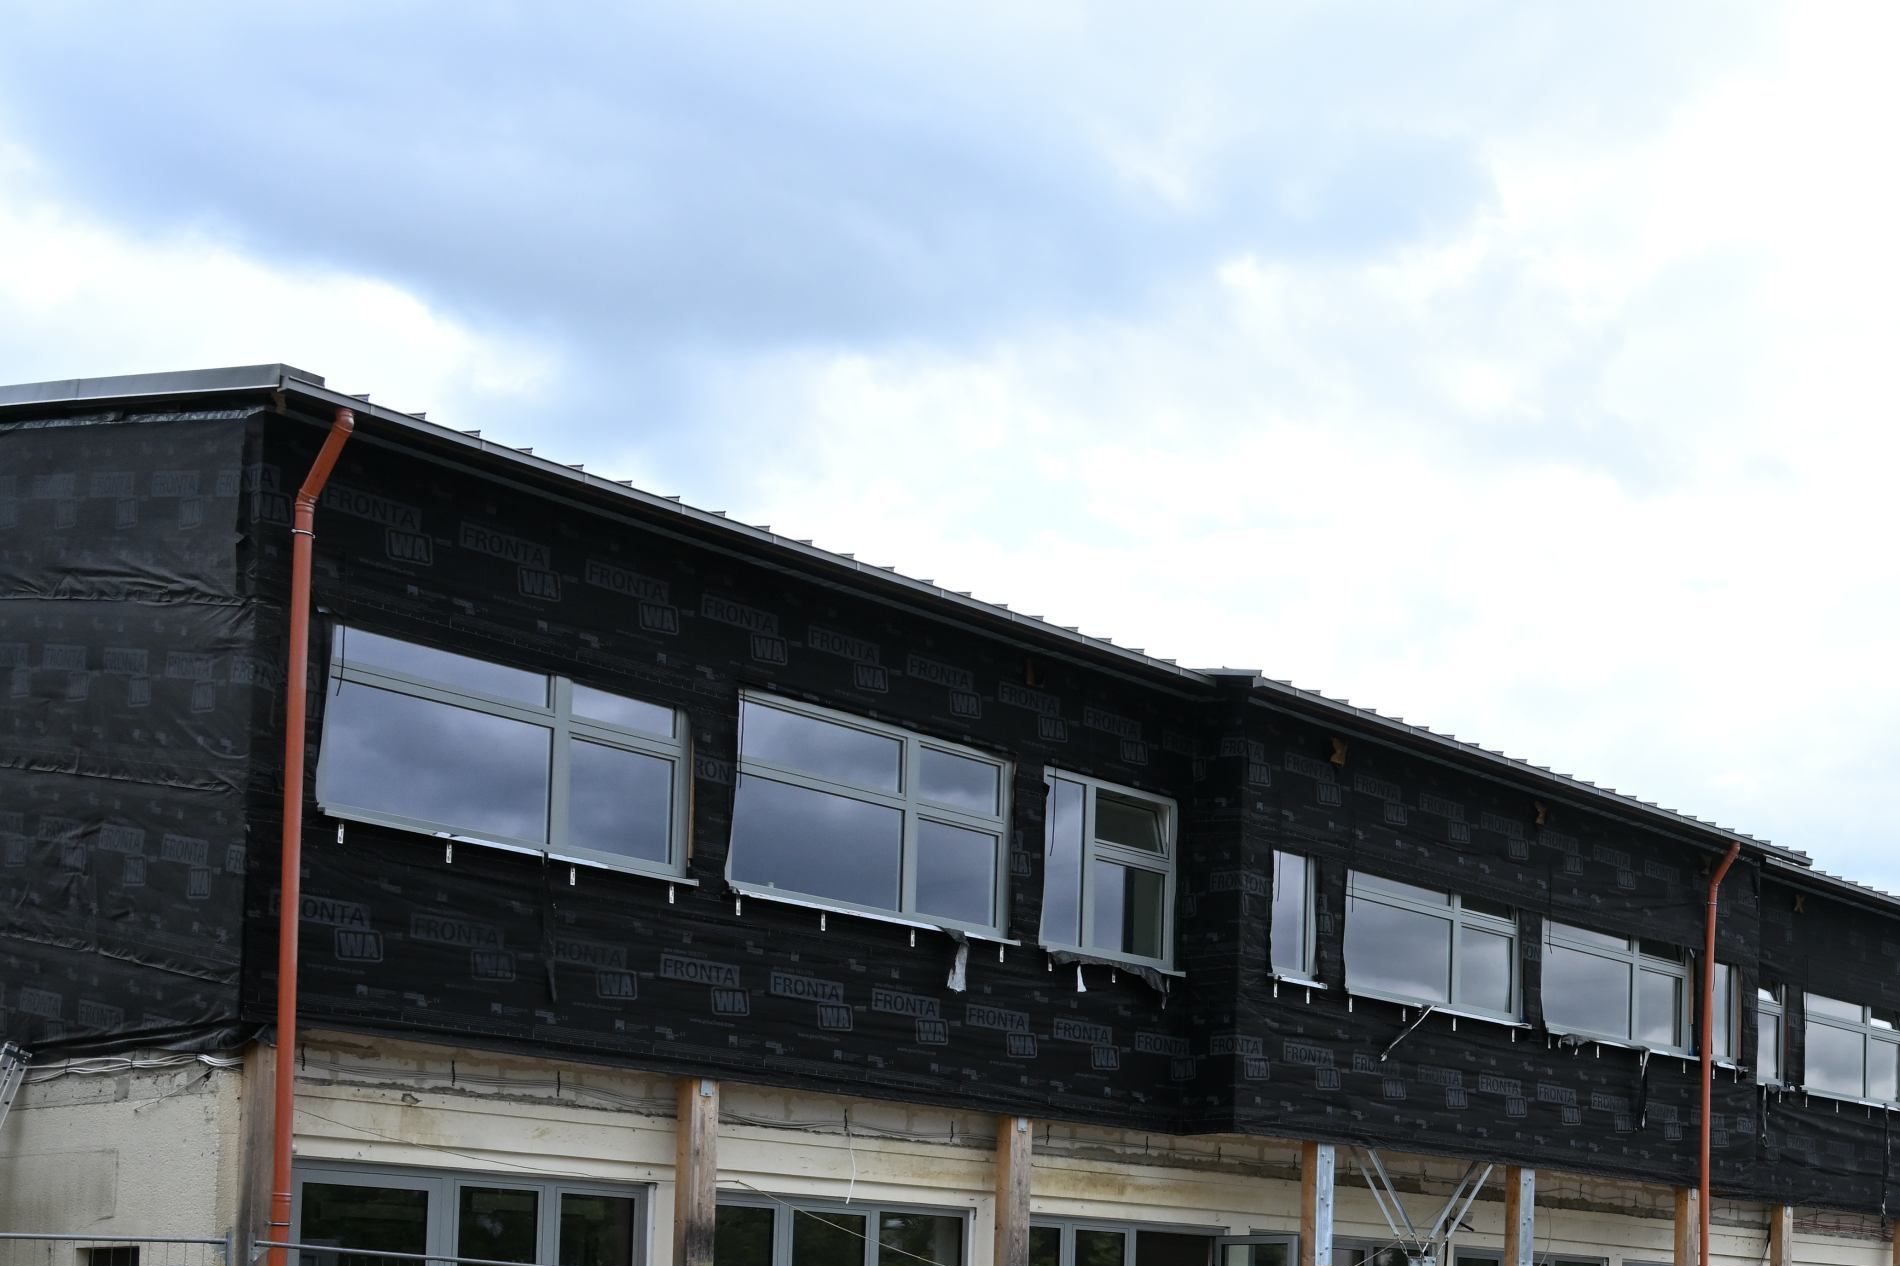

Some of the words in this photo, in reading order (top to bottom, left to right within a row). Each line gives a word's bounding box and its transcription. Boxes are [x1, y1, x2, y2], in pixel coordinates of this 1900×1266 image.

[327, 488, 416, 530] FRONTA
[389, 533, 430, 564] WA
[463, 527, 545, 567] FRONTA
[522, 572, 558, 599] WA
[589, 565, 664, 601] FRONTA
[643, 605, 676, 632] WA
[703, 599, 774, 633] FRONTA
[754, 637, 784, 662] WA
[810, 629, 875, 662] FRONTA
[856, 666, 886, 690] WA
[910, 660, 969, 689] FRONTA
[953, 693, 979, 716] WA
[1001, 686, 1058, 713] FRONTA
[1041, 718, 1066, 739] WA
[1086, 712, 1142, 738] FRONTA
[1122, 742, 1146, 762] WA
[1318, 784, 1340, 805] WA
[1355, 776, 1400, 800] FRONTA
[1385, 803, 1406, 824] WA
[1450, 822, 1470, 841] WA
[1509, 840, 1528, 858] WA
[1565, 855, 1583, 873] WA
[271, 892, 365, 928] FONTA
[413, 919, 498, 947] FRONTA
[338, 932, 380, 959] WA
[556, 940, 623, 969] RONTA
[663, 958, 737, 985] FRONTA
[600, 974, 634, 996] WA
[773, 975, 840, 1001] FRONTA
[714, 990, 747, 1012] WA
[874, 992, 937, 1017] FRONTA
[820, 1006, 851, 1028] WA
[968, 1007, 1027, 1031] FRONTA
[918, 1020, 946, 1042] WA
[1055, 1021, 1110, 1044] FRONTA
[1009, 1034, 1036, 1056] WA
[1136, 1034, 1189, 1055] FRONTA
[1211, 1036, 1261, 1054] FRONTA
[1285, 1044, 1331, 1065] FRONTA
[1093, 1046, 1118, 1068] WA
[1246, 1058, 1268, 1078] WA
[1317, 1069, 1339, 1089] WA
[1384, 1079, 1405, 1098] WA
[1480, 1074, 1521, 1095] FRONTA
[1447, 1088, 1467, 1108] WA
[1507, 1096, 1526, 1116] WA
[1539, 1085, 1576, 1105] FRONTA
[1563, 1107, 1580, 1124] WA
